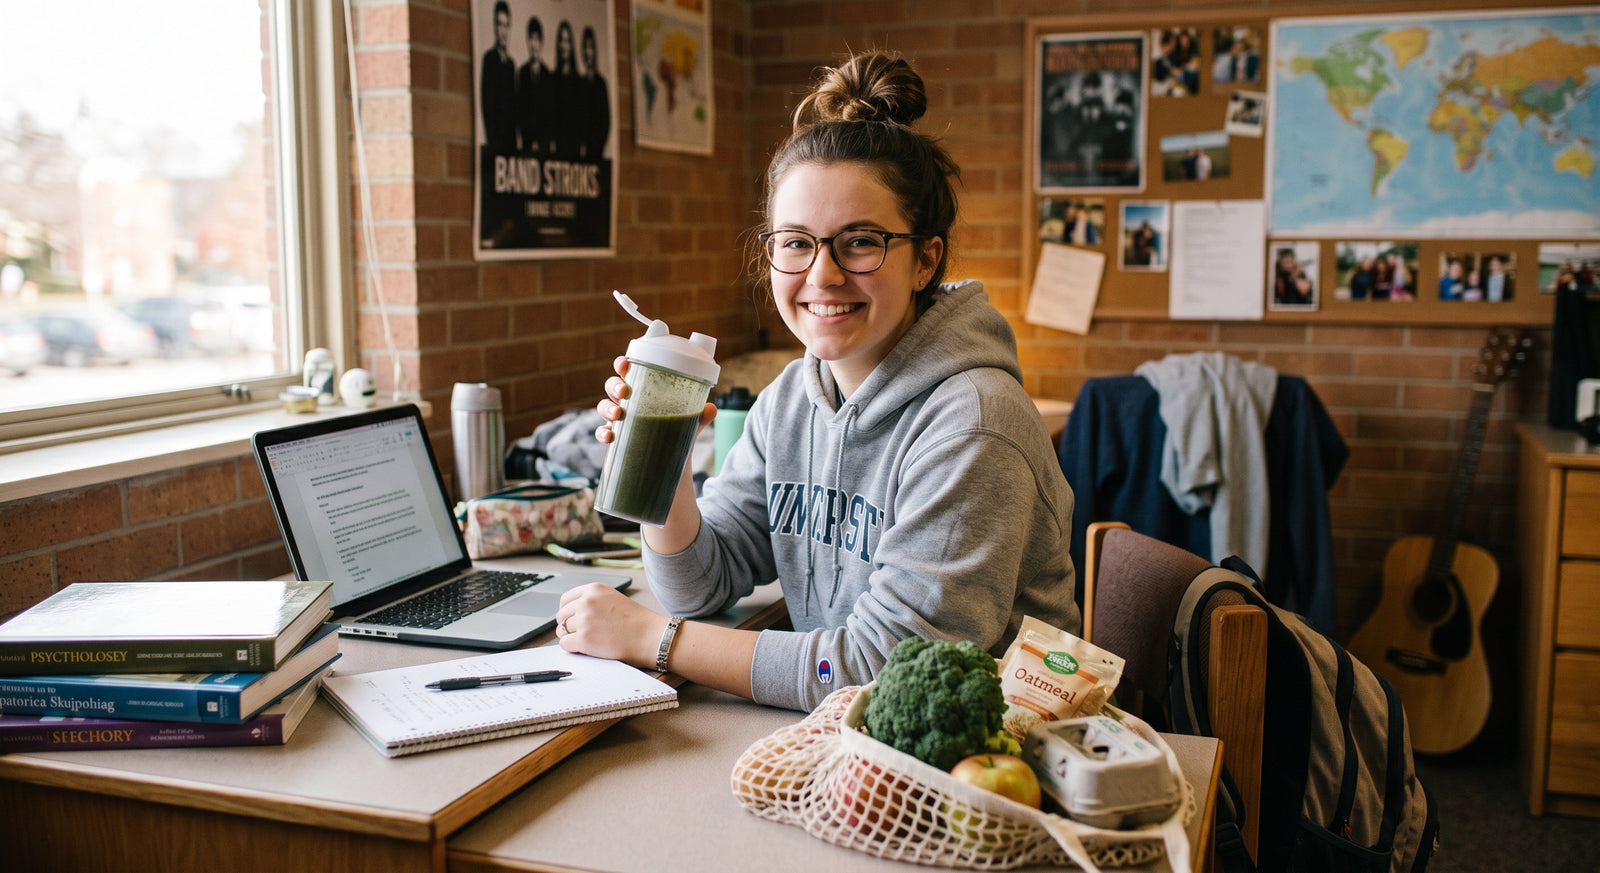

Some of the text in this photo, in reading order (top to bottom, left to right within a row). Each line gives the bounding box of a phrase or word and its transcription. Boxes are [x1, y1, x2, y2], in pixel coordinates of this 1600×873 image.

[495, 156, 540, 193] BAND
[31, 651, 128, 663] PSYCTHOLOSEY
[1015, 668, 1077, 704] Oatmeal
[52, 730, 133, 743] SEECHORY
